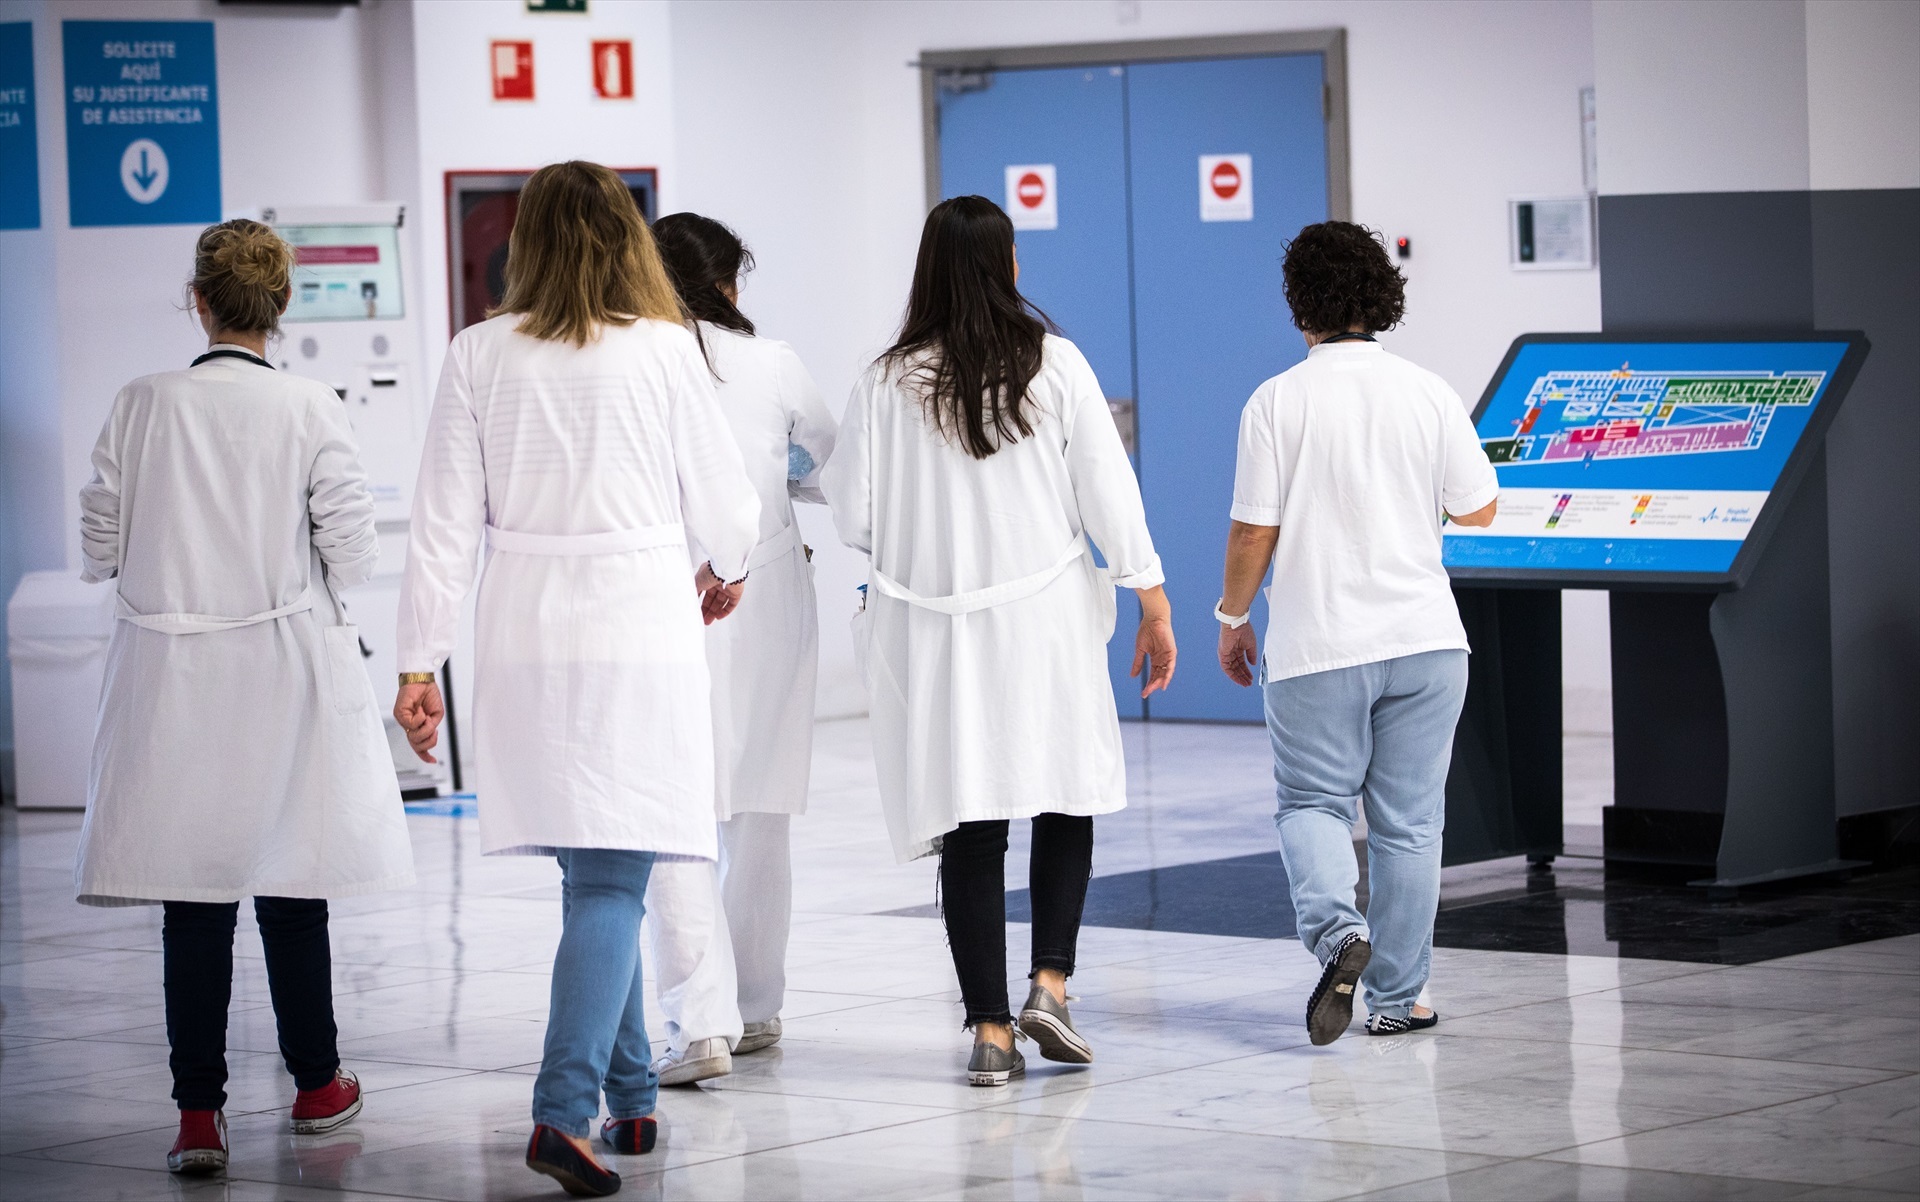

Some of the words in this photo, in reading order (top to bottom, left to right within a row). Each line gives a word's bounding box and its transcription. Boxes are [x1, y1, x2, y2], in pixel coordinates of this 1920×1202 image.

[103, 42, 175, 58] SOLICITE
[121, 62, 161, 83] AQUÍ
[72, 86, 95, 103] SU
[100, 85, 208, 102] JUSTIFICANTE
[82, 108, 103, 125] DE
[108, 107, 203, 124] ASISTENCIA
